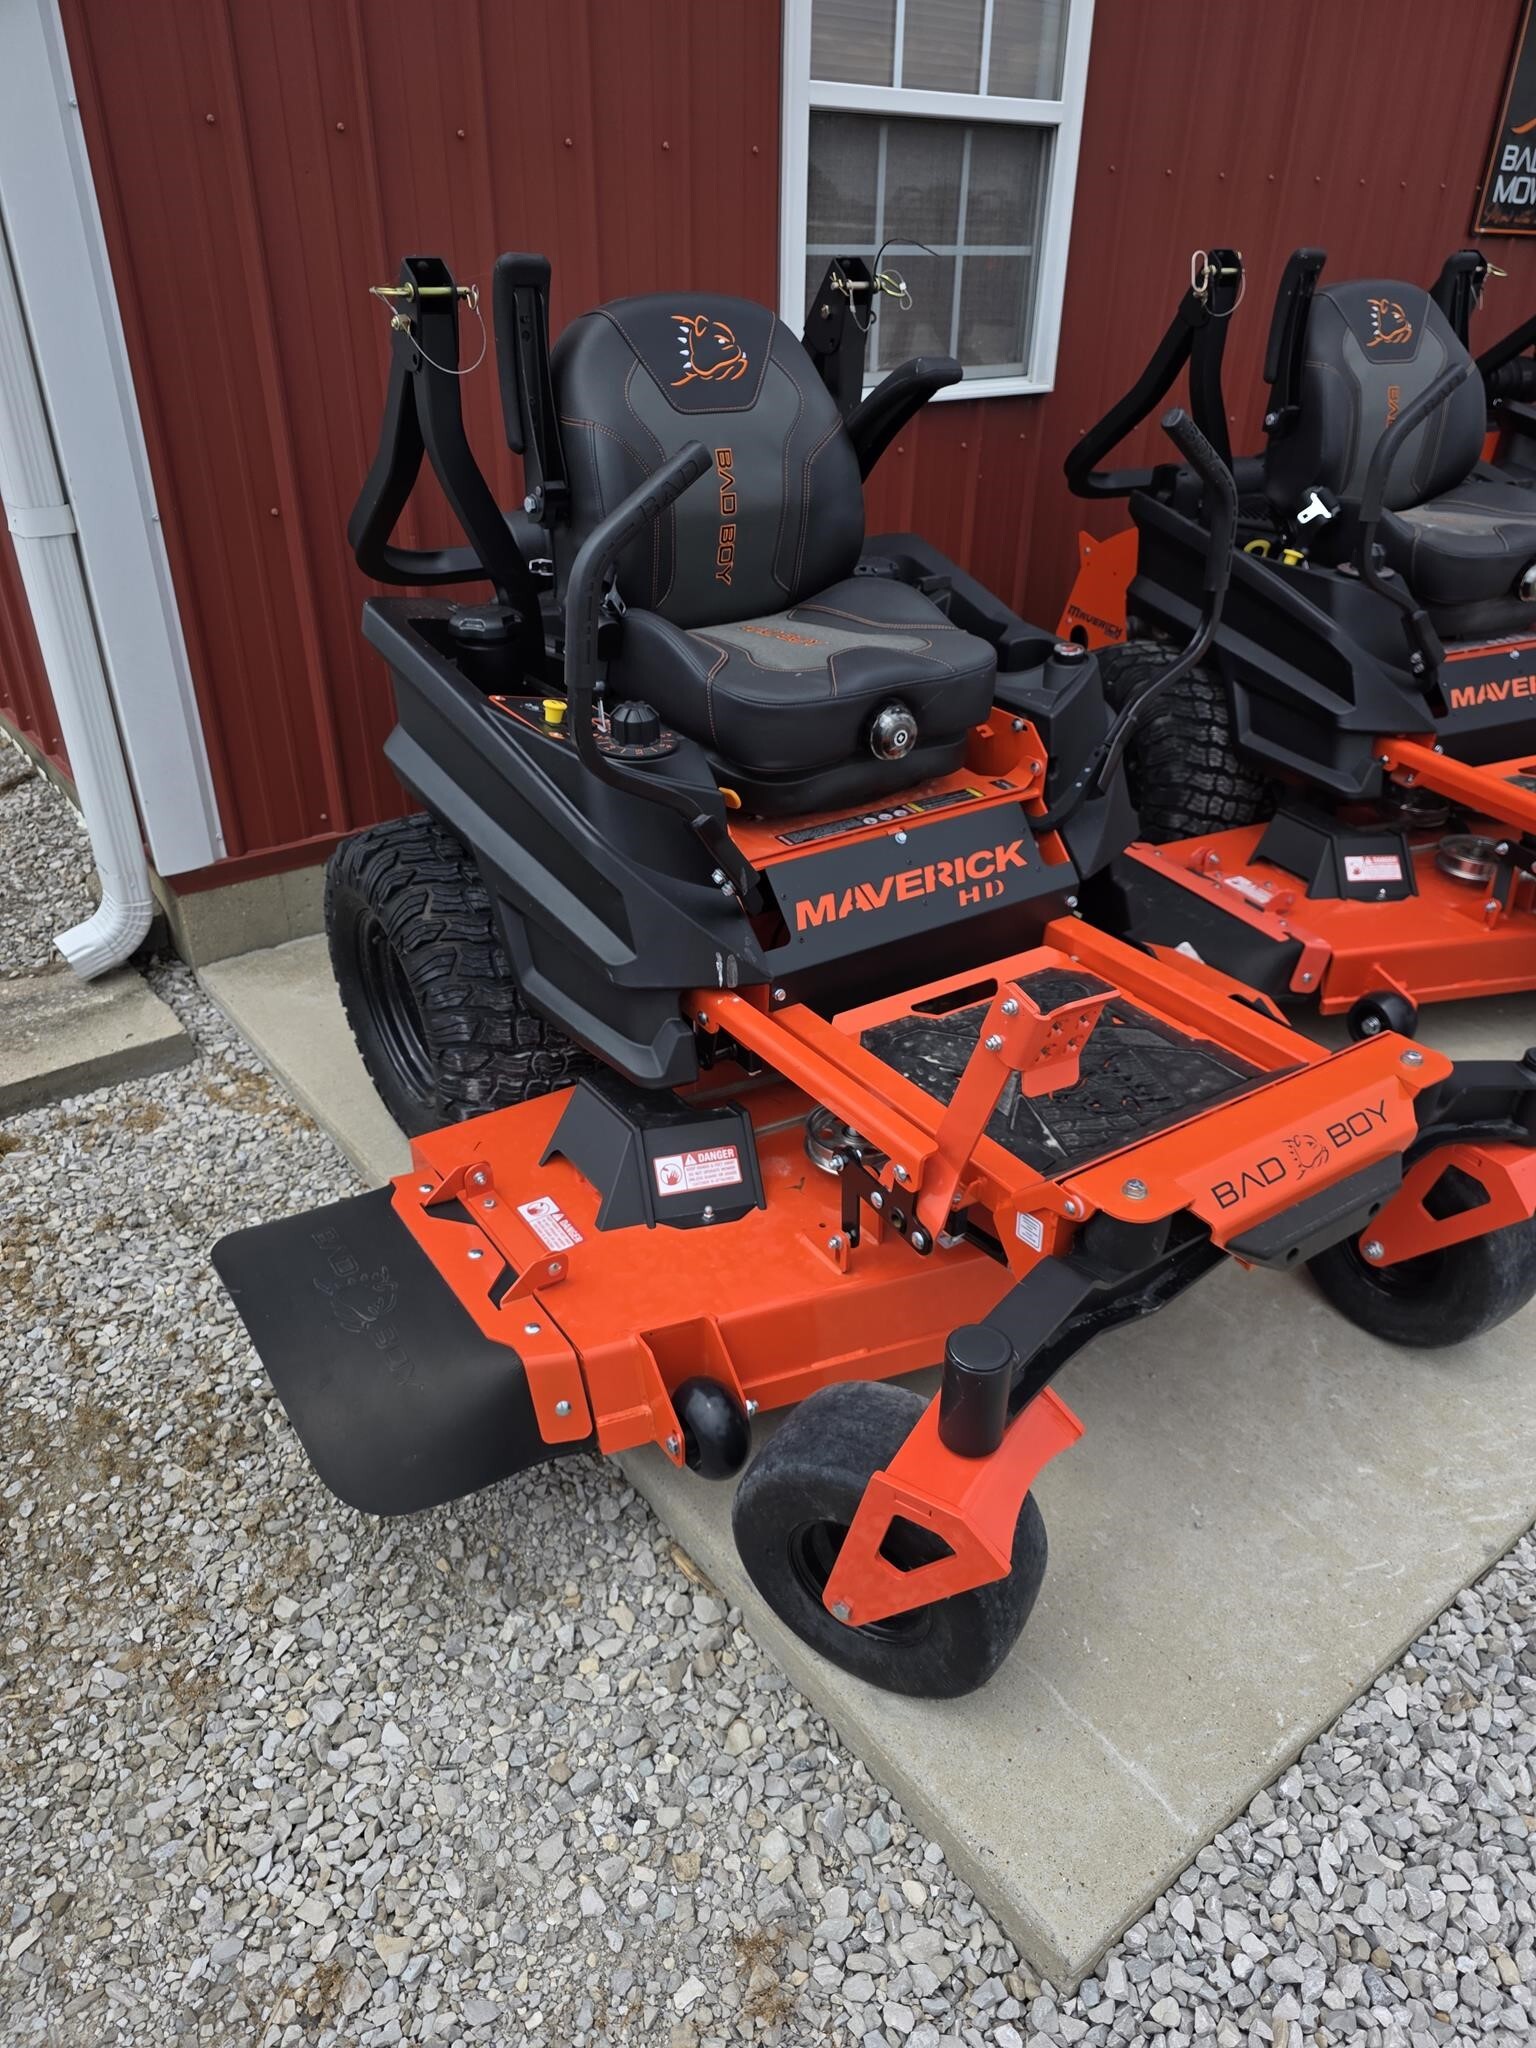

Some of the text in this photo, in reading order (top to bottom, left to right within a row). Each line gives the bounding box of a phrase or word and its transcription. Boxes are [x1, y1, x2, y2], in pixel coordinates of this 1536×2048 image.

[714, 447, 737, 586] BAD BOY
[795, 839, 1028, 932] MAVERICK
[958, 879, 1005, 907] HD
[697, 1148, 735, 1164] DANGER
[1210, 1099, 1387, 1209] BAD BOY
